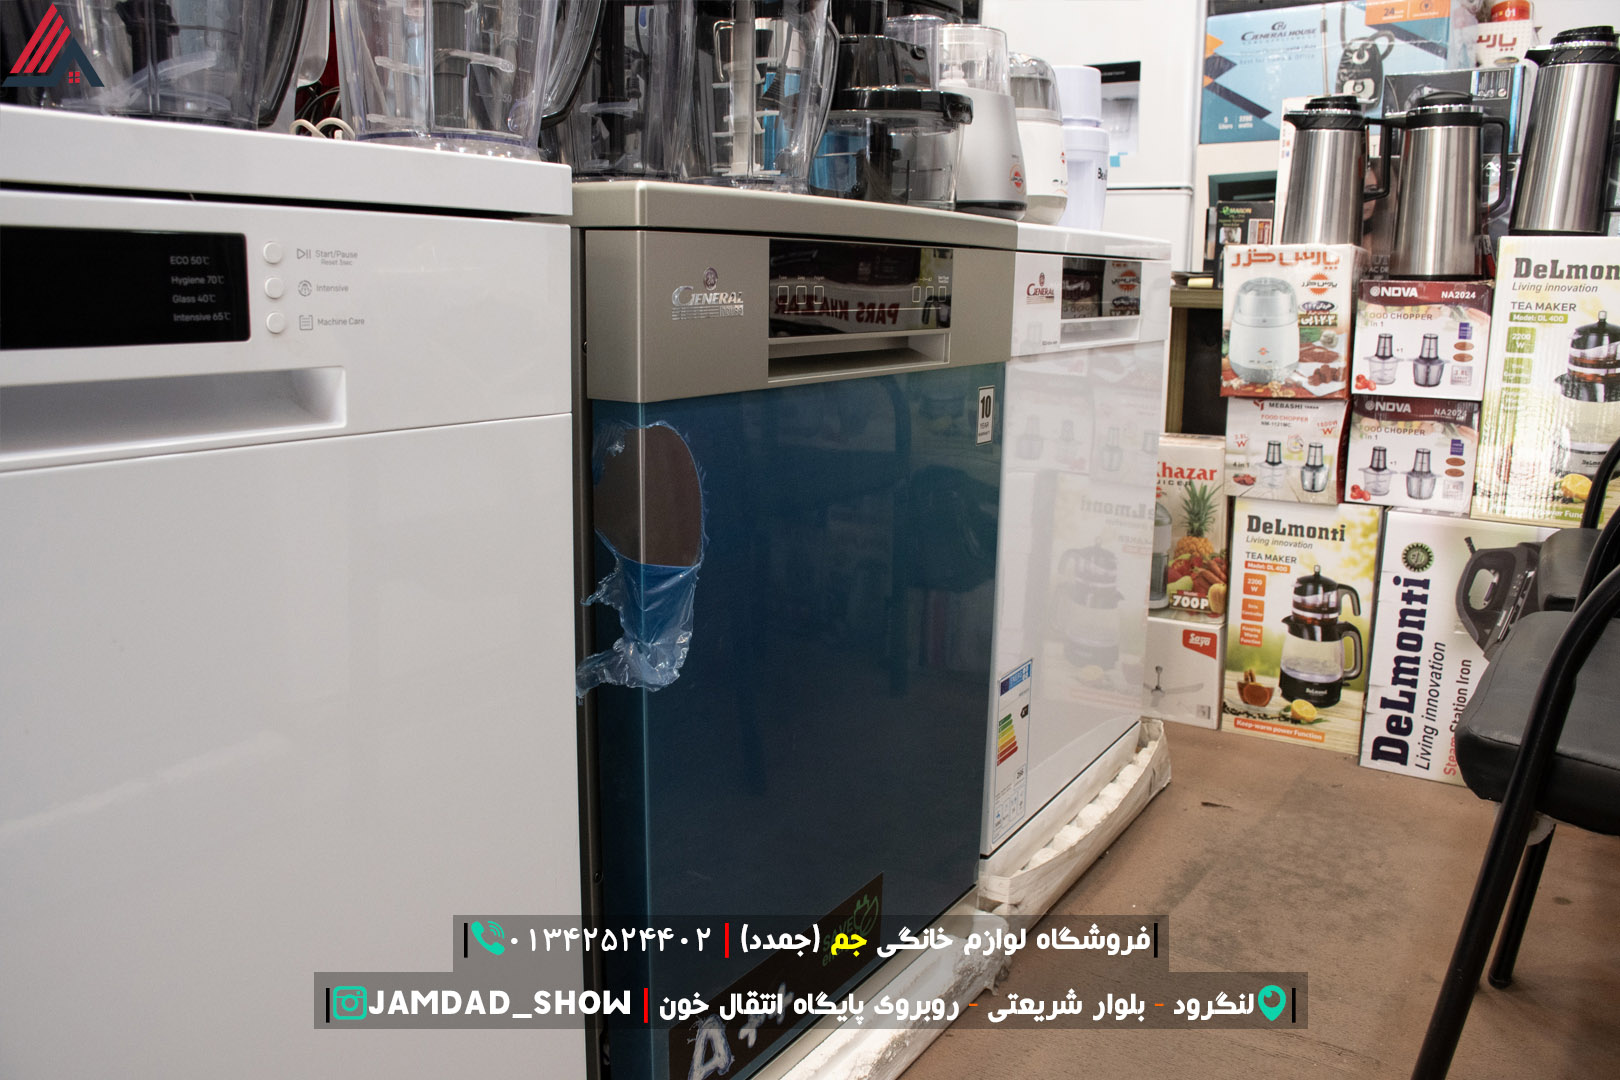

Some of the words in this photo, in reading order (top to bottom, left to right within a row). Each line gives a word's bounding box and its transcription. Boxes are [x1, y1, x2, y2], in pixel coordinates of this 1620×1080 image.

[1241, 31, 1287, 41] GENERAL
[170, 256, 188, 265] ECO
[315, 249, 358, 259] Start/Pause
[1231, 248, 1276, 267] خزر
[1279, 251, 1340, 270] پارس
[171, 276, 206, 286] Hygiene
[1512, 282, 1543, 293] Living
[1544, 283, 1599, 293] innovation
[316, 284, 349, 293] Intensive
[1026, 283, 1055, 296] GENERAL
[1380, 286, 1418, 298] NOVA
[1441, 291, 1477, 299] NA2024
[172, 294, 196, 304] Glass
[672, 285, 744, 307] GENERAL
[1511, 301, 1532, 311] TEA
[1535, 302, 1577, 312] MAKER
[173, 313, 212, 322] Intensive
[317, 317, 348, 326] Machine
[348, 317, 365, 326] Care
[1390, 313, 1433, 321] CHOPPER
[980, 395, 991, 418] 10
[1375, 402, 1411, 413] NOVA
[1433, 408, 1467, 417] NA2024
[1384, 427, 1426, 436] CHOPPER
[1157, 462, 1217, 481] hazar
[1246, 514, 1346, 541] DeLmonti
[1246, 535, 1270, 546] Living
[1271, 537, 1313, 549] innovation
[1245, 551, 1263, 560] TEA
[1264, 553, 1297, 563] MAKER
[1172, 595, 1209, 609] 700P
[1370, 574, 1431, 766] DeLmonti
[1456, 659, 1472, 685] Iron
[1424, 641, 1446, 723] innovation
[1236, 719, 1273, 731] Keep-warm
[1273, 726, 1293, 736] power
[1293, 729, 1323, 740] Function
[1415, 725, 1440, 771] Living
